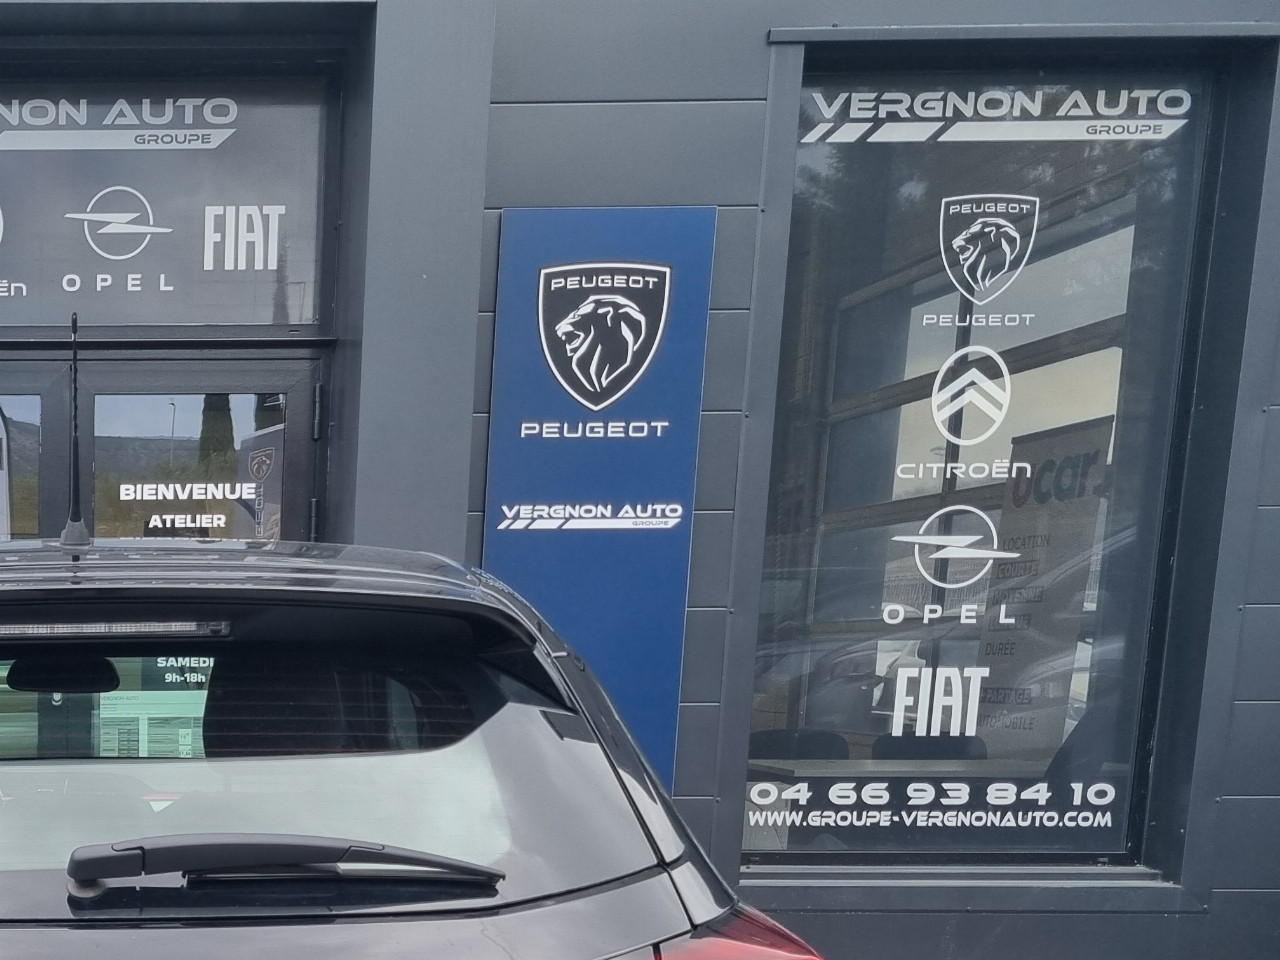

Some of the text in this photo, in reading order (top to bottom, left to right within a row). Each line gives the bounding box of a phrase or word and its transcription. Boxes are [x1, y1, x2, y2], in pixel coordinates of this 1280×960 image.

[102, 97, 238, 125] AUTO
[812, 88, 1192, 119] VERGNON AUTO
[1085, 124, 1163, 136] GROUPE
[133, 133, 212, 145] GROUPE
[949, 202, 1031, 215] PEUGEOT
[203, 205, 286, 270] FIAT
[62, 274, 174, 292] OPEL
[551, 274, 659, 291] PEUGEOT
[922, 313, 1036, 327] PEUGEOT
[520, 421, 670, 438] PEUGEOT
[896, 460, 1032, 479] CITROËN
[120, 482, 257, 501] BIENVENUE
[501, 503, 683, 518] VERGNON AUTO
[148, 514, 226, 528] ATELIER
[882, 604, 1016, 624] OPEL
[156, 656, 214, 668] SAMEDI
[164, 672, 206, 683] 9h-18h
[891, 667, 990, 736] FIAT
[750, 783, 1116, 805] 04 66 93 84 10
[748, 811, 1112, 828] WWW.GROUPE-VERGNONAUTO.COM
